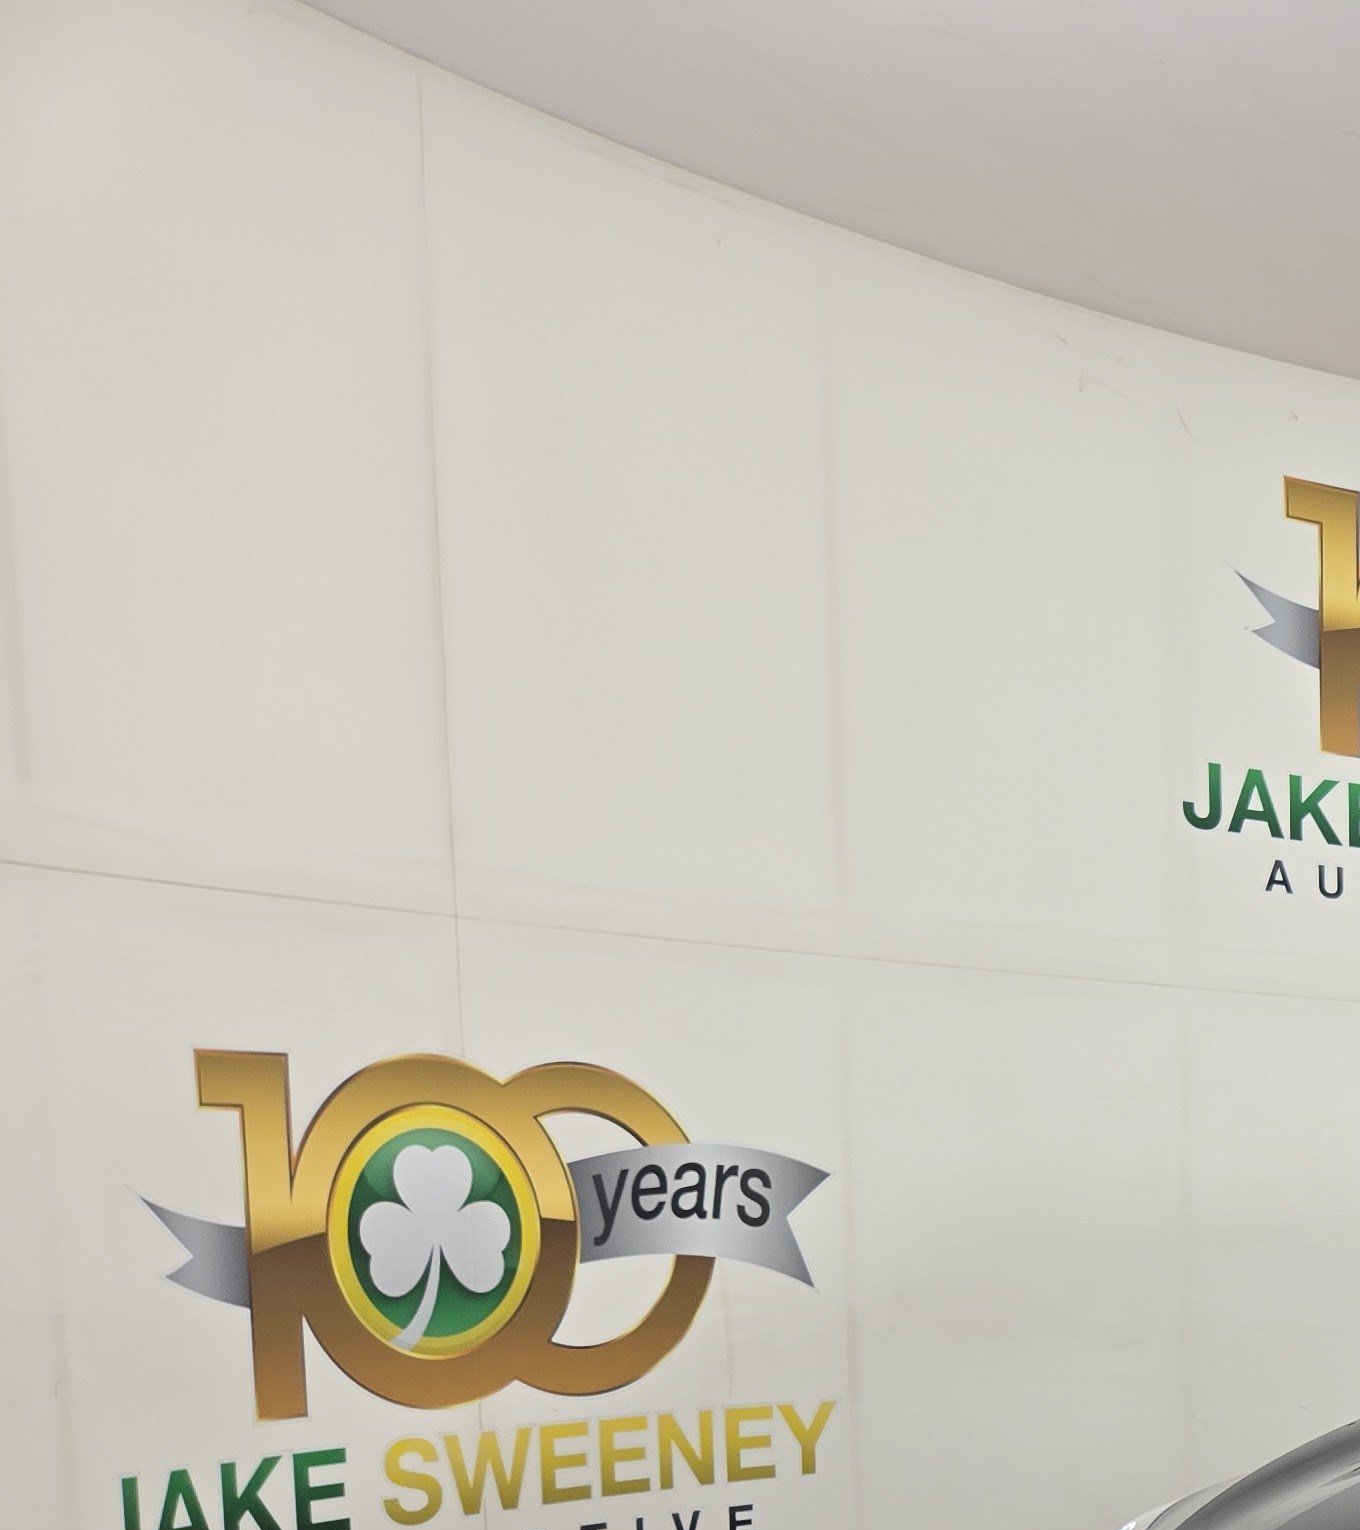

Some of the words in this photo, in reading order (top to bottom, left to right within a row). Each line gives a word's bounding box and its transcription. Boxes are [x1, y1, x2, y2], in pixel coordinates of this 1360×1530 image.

[194, 1048, 716, 1422] 100
[592, 1160, 774, 1247] years
[382, 1401, 838, 1527] SWEENEY
